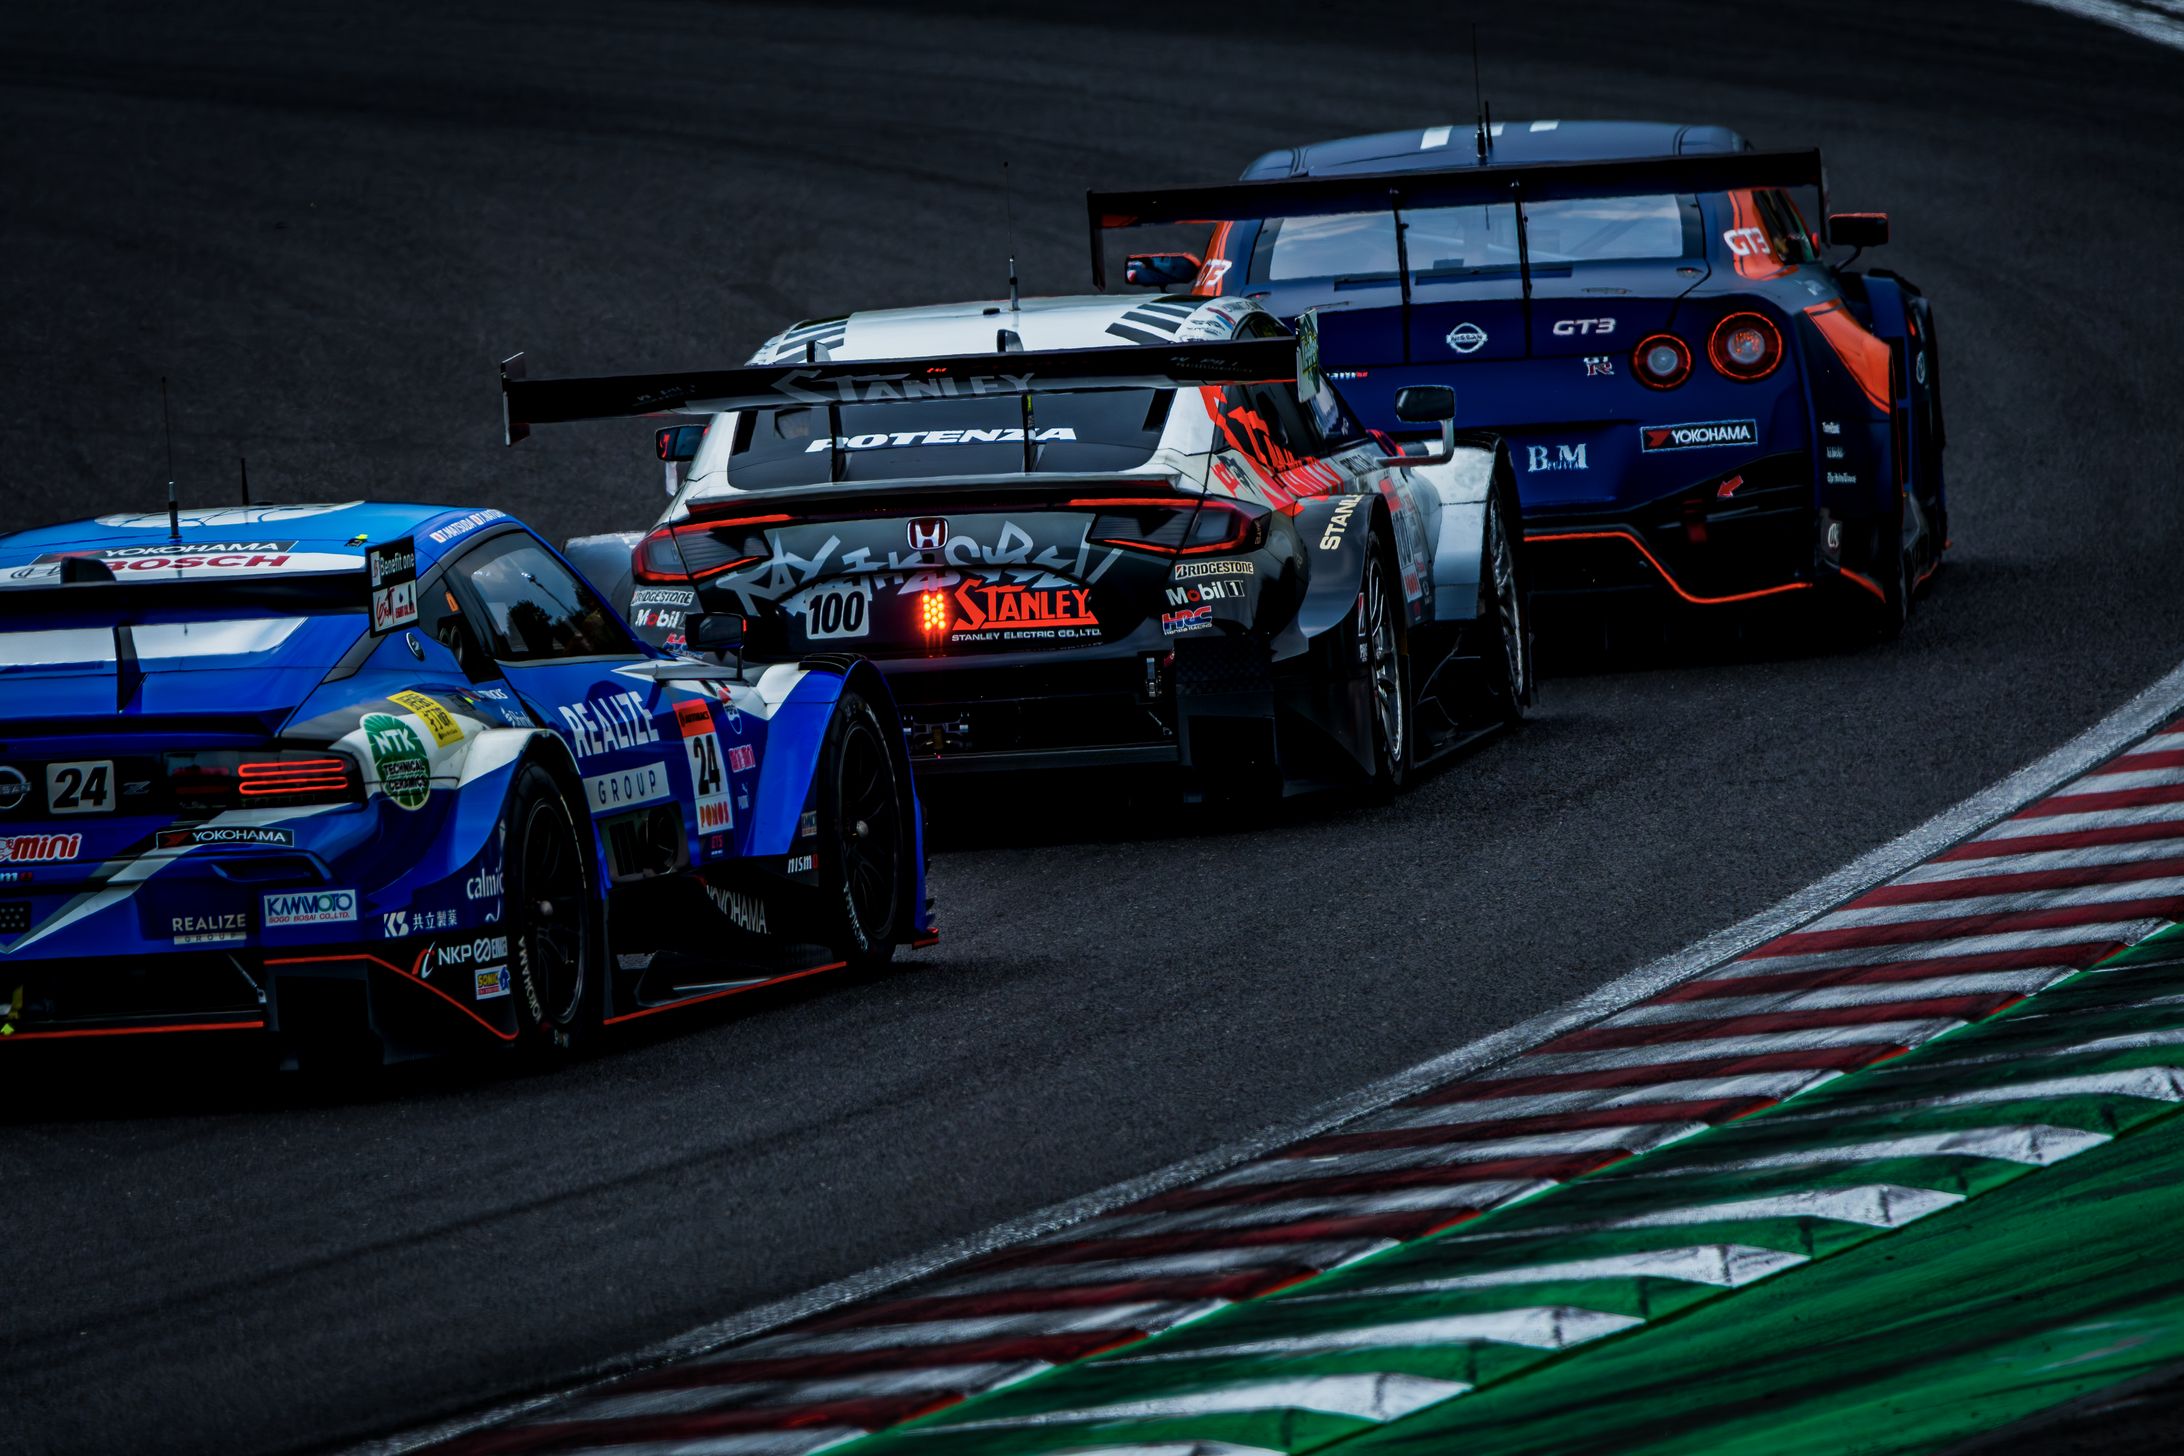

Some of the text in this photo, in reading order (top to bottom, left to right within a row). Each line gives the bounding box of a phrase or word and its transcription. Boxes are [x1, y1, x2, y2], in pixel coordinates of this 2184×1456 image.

[1723, 226, 1771, 257] GT3
[1552, 317, 1617, 336] GT3
[770, 368, 1036, 403] STANLEY
[804, 427, 1078, 453] POTENZA
[1671, 425, 1751, 445] YOKOHAMA
[104, 543, 280, 557] YOKOHAMA
[1176, 562, 1254, 579] BRIDGESTONE
[951, 578, 1100, 631] STANLEY
[1165, 580, 1226, 607] Mobil
[634, 608, 681, 629] Mobil
[810, 590, 866, 635] 100
[1162, 606, 1213, 632] HRC
[952, 632, 1000, 642] STANLEY
[1003, 629, 1055, 640] ELECTRIC
[557, 690, 661, 759] REALIZE
[372, 728, 416, 755] NTK
[383, 759, 426, 777] TECHNICAL
[693, 734, 721, 796] 24
[53, 766, 108, 809] 24
[387, 776, 428, 792] CERAMICS
[598, 769, 656, 805] GROUP
[699, 801, 729, 828] PONOS
[11, 834, 82, 861] mini
[191, 828, 287, 843] YOKOHAMA
[787, 853, 819, 874] nismo
[466, 866, 505, 900] calmic
[171, 913, 248, 932] REALIZE
[269, 916, 291, 924] SOGO
[184, 932, 239, 943] GROUP
[437, 944, 473, 967] NKP
